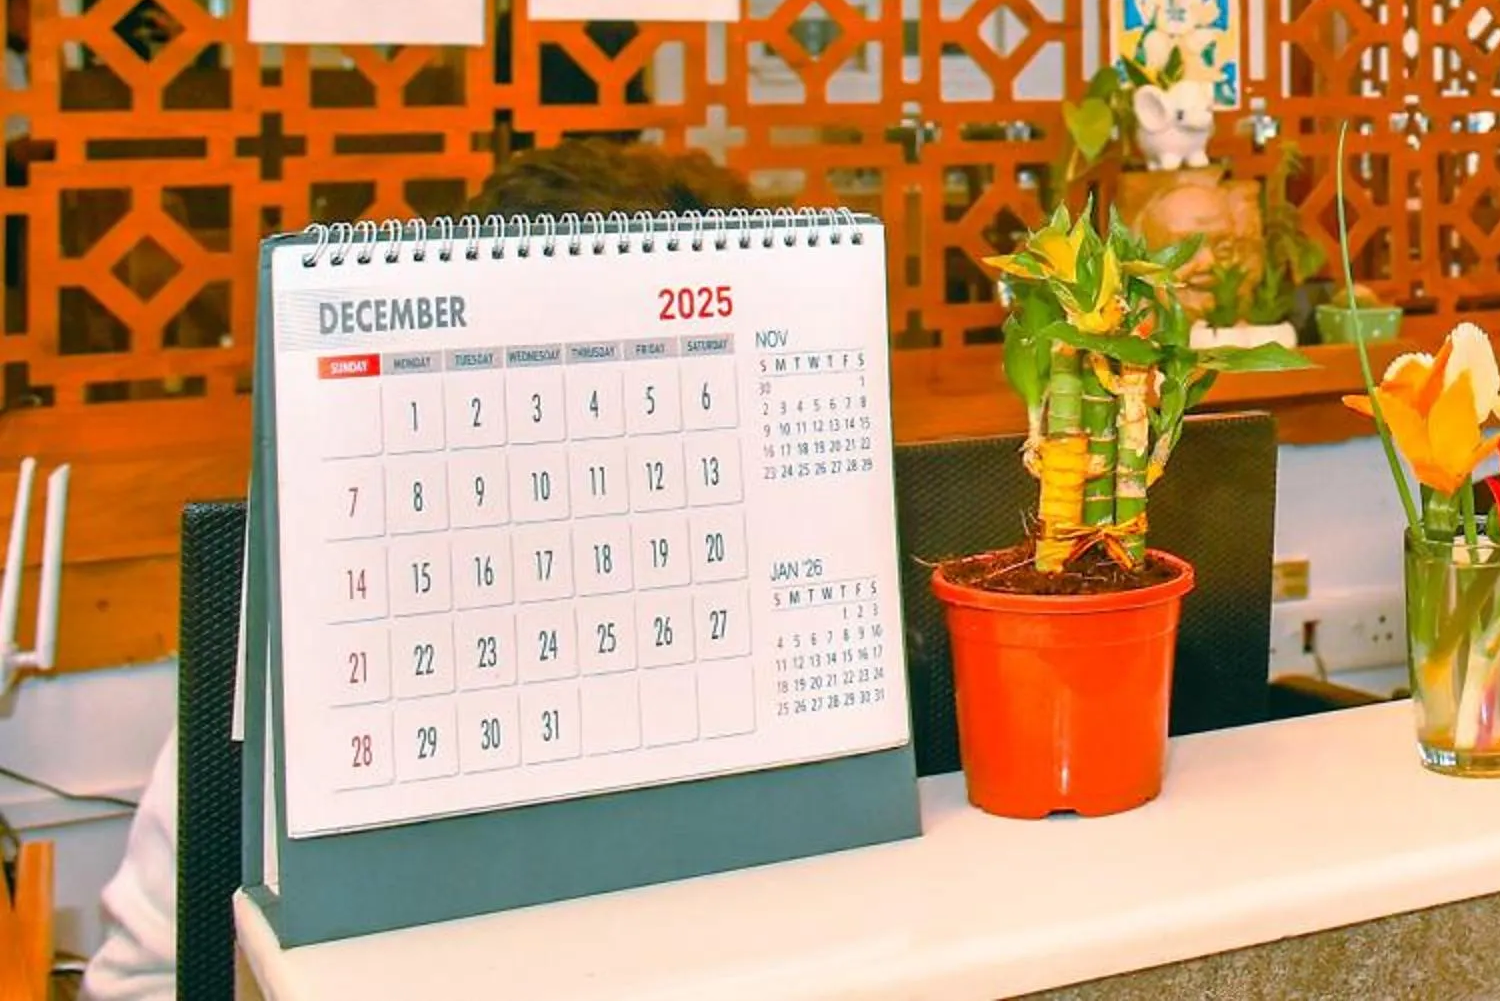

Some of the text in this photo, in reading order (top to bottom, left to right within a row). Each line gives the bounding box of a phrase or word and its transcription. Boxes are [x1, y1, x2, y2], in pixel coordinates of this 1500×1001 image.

[319, 296, 467, 334] DECEMBER
[658, 286, 733, 320] 2025
[331, 360, 368, 374] SUNDAY
[394, 356, 430, 369] MONDAY
[455, 353, 493, 367] TUESDAY
[510, 350, 559, 361] WEDNESDAY
[636, 344, 665, 354] FRIDAY
[687, 340, 728, 351] SATURDAY
[755, 330, 788, 348] NOV
[410, 382, 711, 432] 1 2 3 4 5 6
[348, 456, 720, 518] 7 8 9 10 11 12 13
[346, 532, 725, 600] 14 15 16 17 18 19 20
[771, 562, 798, 581] JAN
[348, 609, 728, 685] 21 22 23 24 25 26 27
[351, 709, 560, 768] 28 29 30 31
